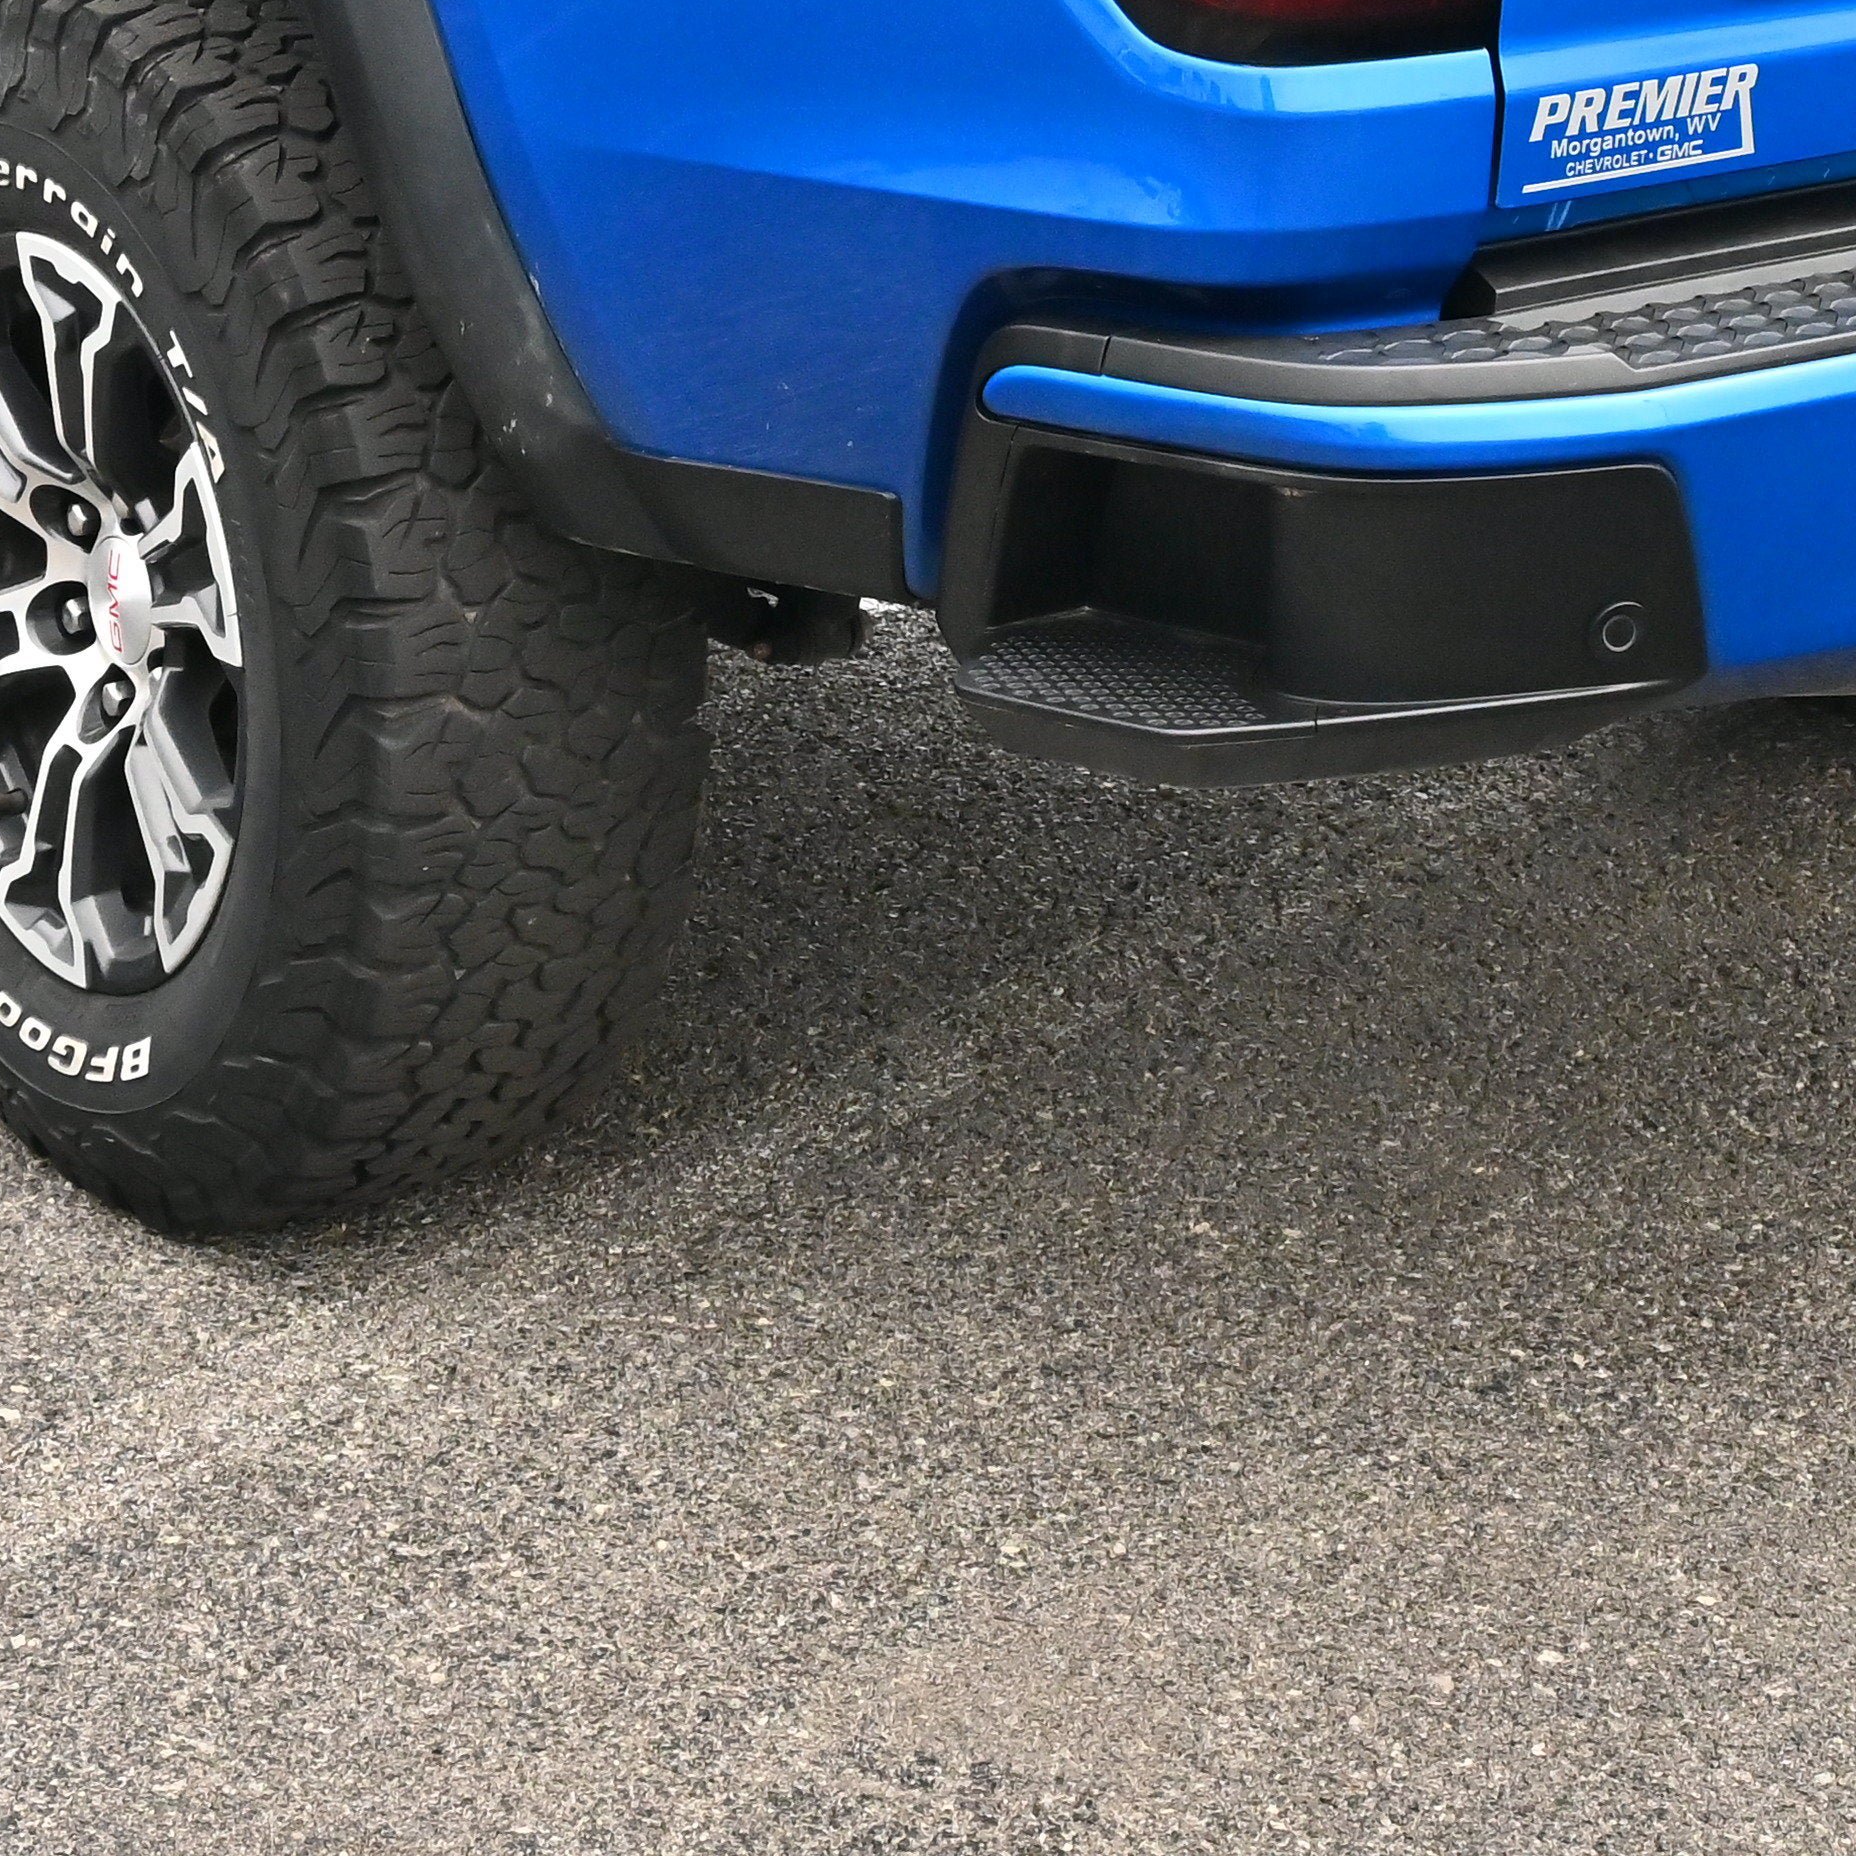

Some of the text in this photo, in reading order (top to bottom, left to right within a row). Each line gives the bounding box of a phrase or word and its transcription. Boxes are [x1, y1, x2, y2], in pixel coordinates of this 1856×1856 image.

[1528, 62, 1759, 143] PREMIER
[1550, 112, 1722, 159] Morgantown, WV
[1565, 139, 1704, 177] CHEVROLET GMC
[166, 329, 227, 483] T/A
[107, 548, 123, 653] GMC
